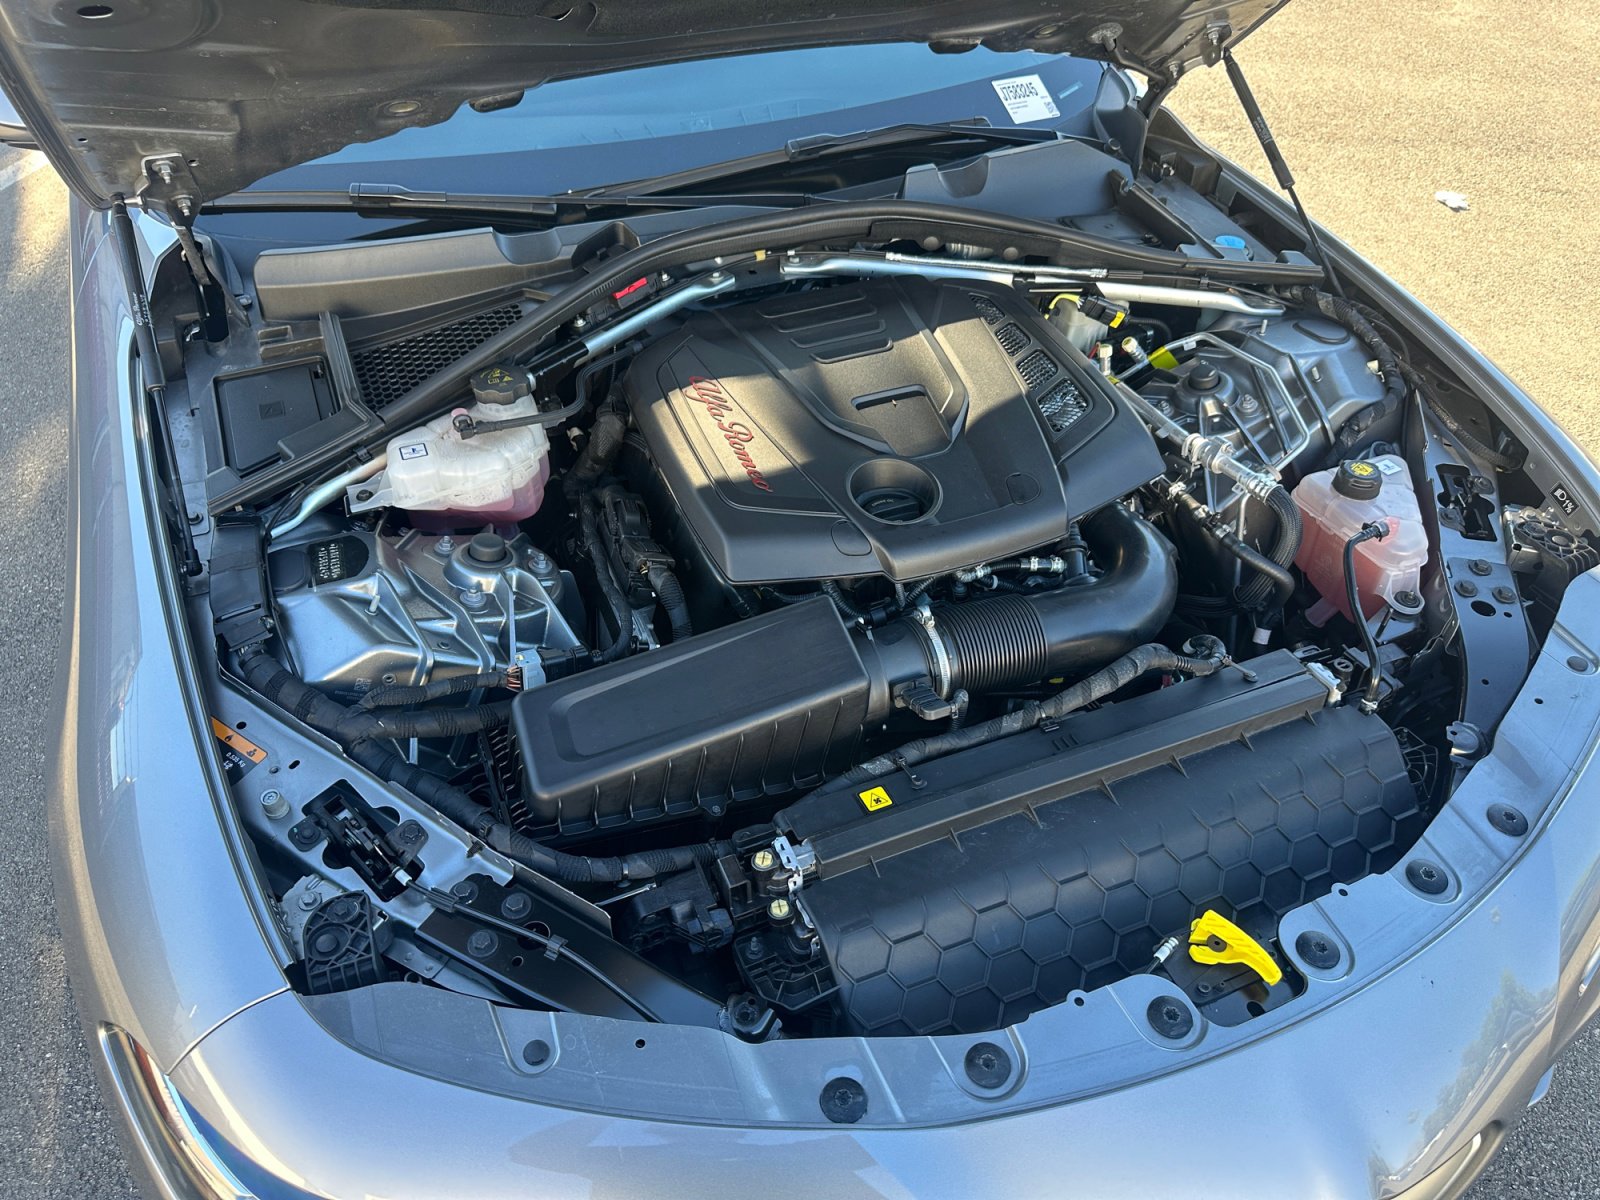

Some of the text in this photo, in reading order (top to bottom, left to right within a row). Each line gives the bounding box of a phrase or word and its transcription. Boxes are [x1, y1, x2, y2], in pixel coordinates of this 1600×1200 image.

[999, 82, 1039, 102] J7583245
[684, 375, 774, 493] Alfa Romeo
[1562, 499, 1575, 514] 1%
